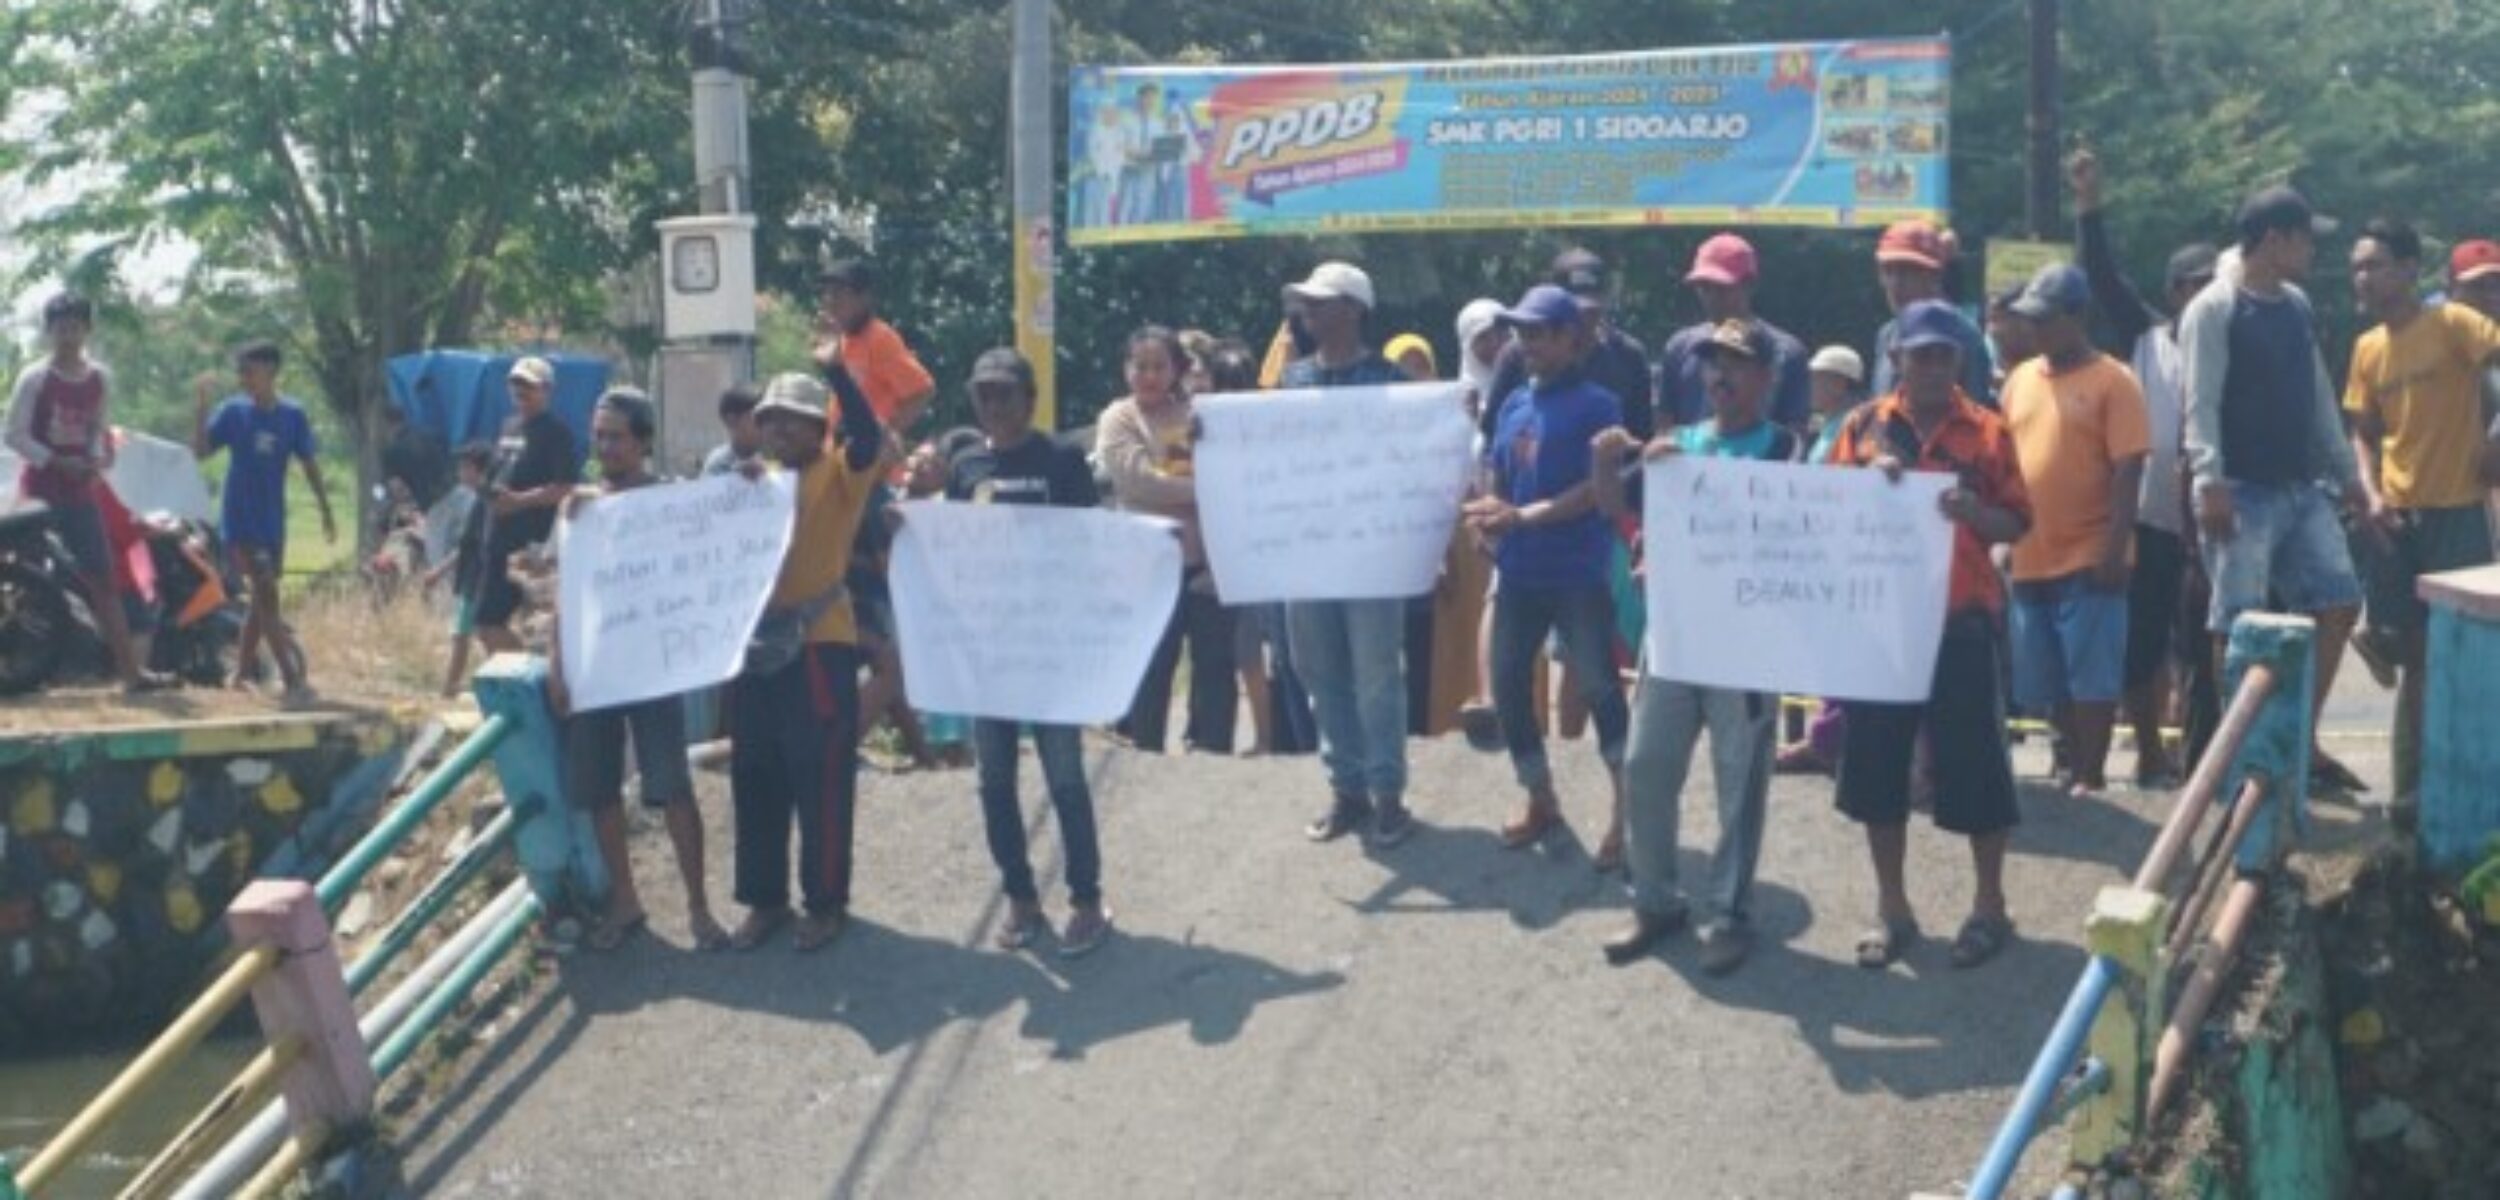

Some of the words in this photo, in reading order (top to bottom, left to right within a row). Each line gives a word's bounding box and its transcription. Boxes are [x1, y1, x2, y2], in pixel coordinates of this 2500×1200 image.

[1224, 92, 1380, 167] PPDB
[1427, 119, 1488, 146] SMK
[1494, 116, 1562, 142] PGRI
[1574, 116, 1586, 140] 1
[1595, 112, 1748, 140] SIDOARJO
